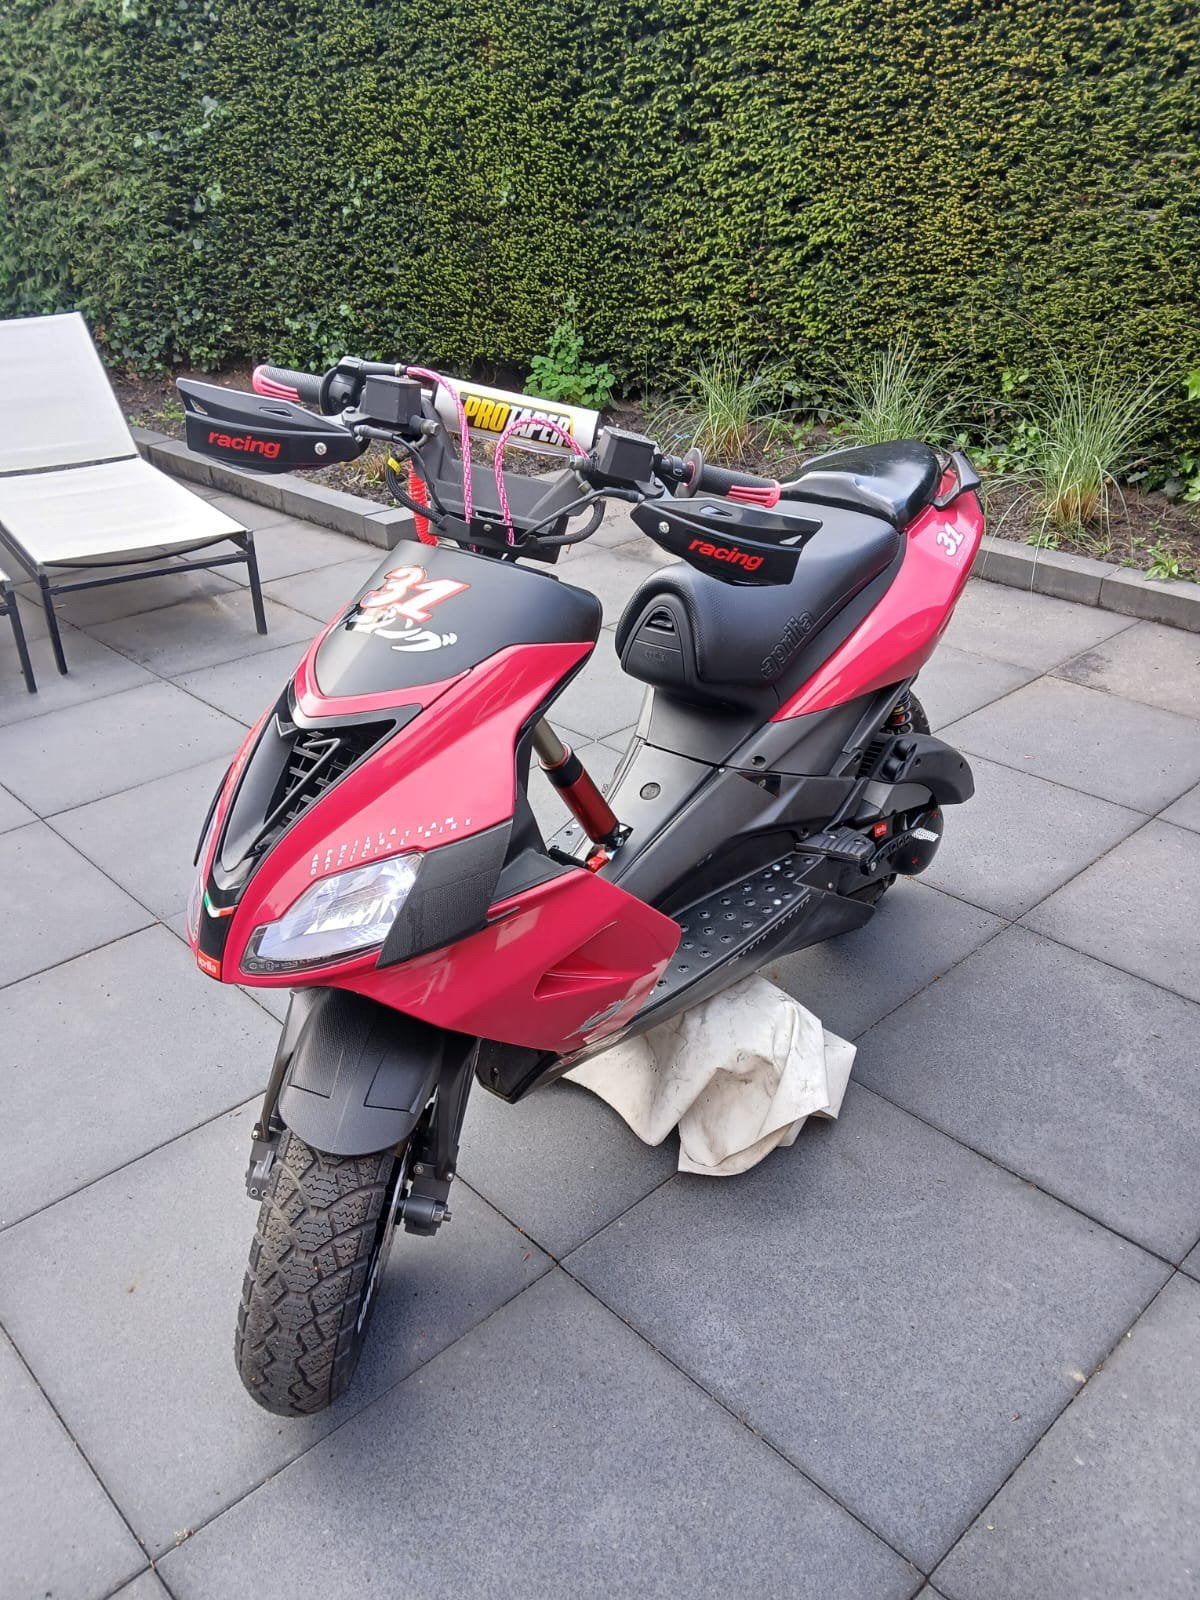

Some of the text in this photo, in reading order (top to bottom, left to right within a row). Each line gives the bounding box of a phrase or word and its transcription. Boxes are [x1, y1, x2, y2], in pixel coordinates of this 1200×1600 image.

[208, 431, 281, 458] racing
[688, 539, 765, 571] racing
[936, 520, 965, 557] 31
[360, 565, 471, 624] 31
[760, 609, 812, 680] aprilia
